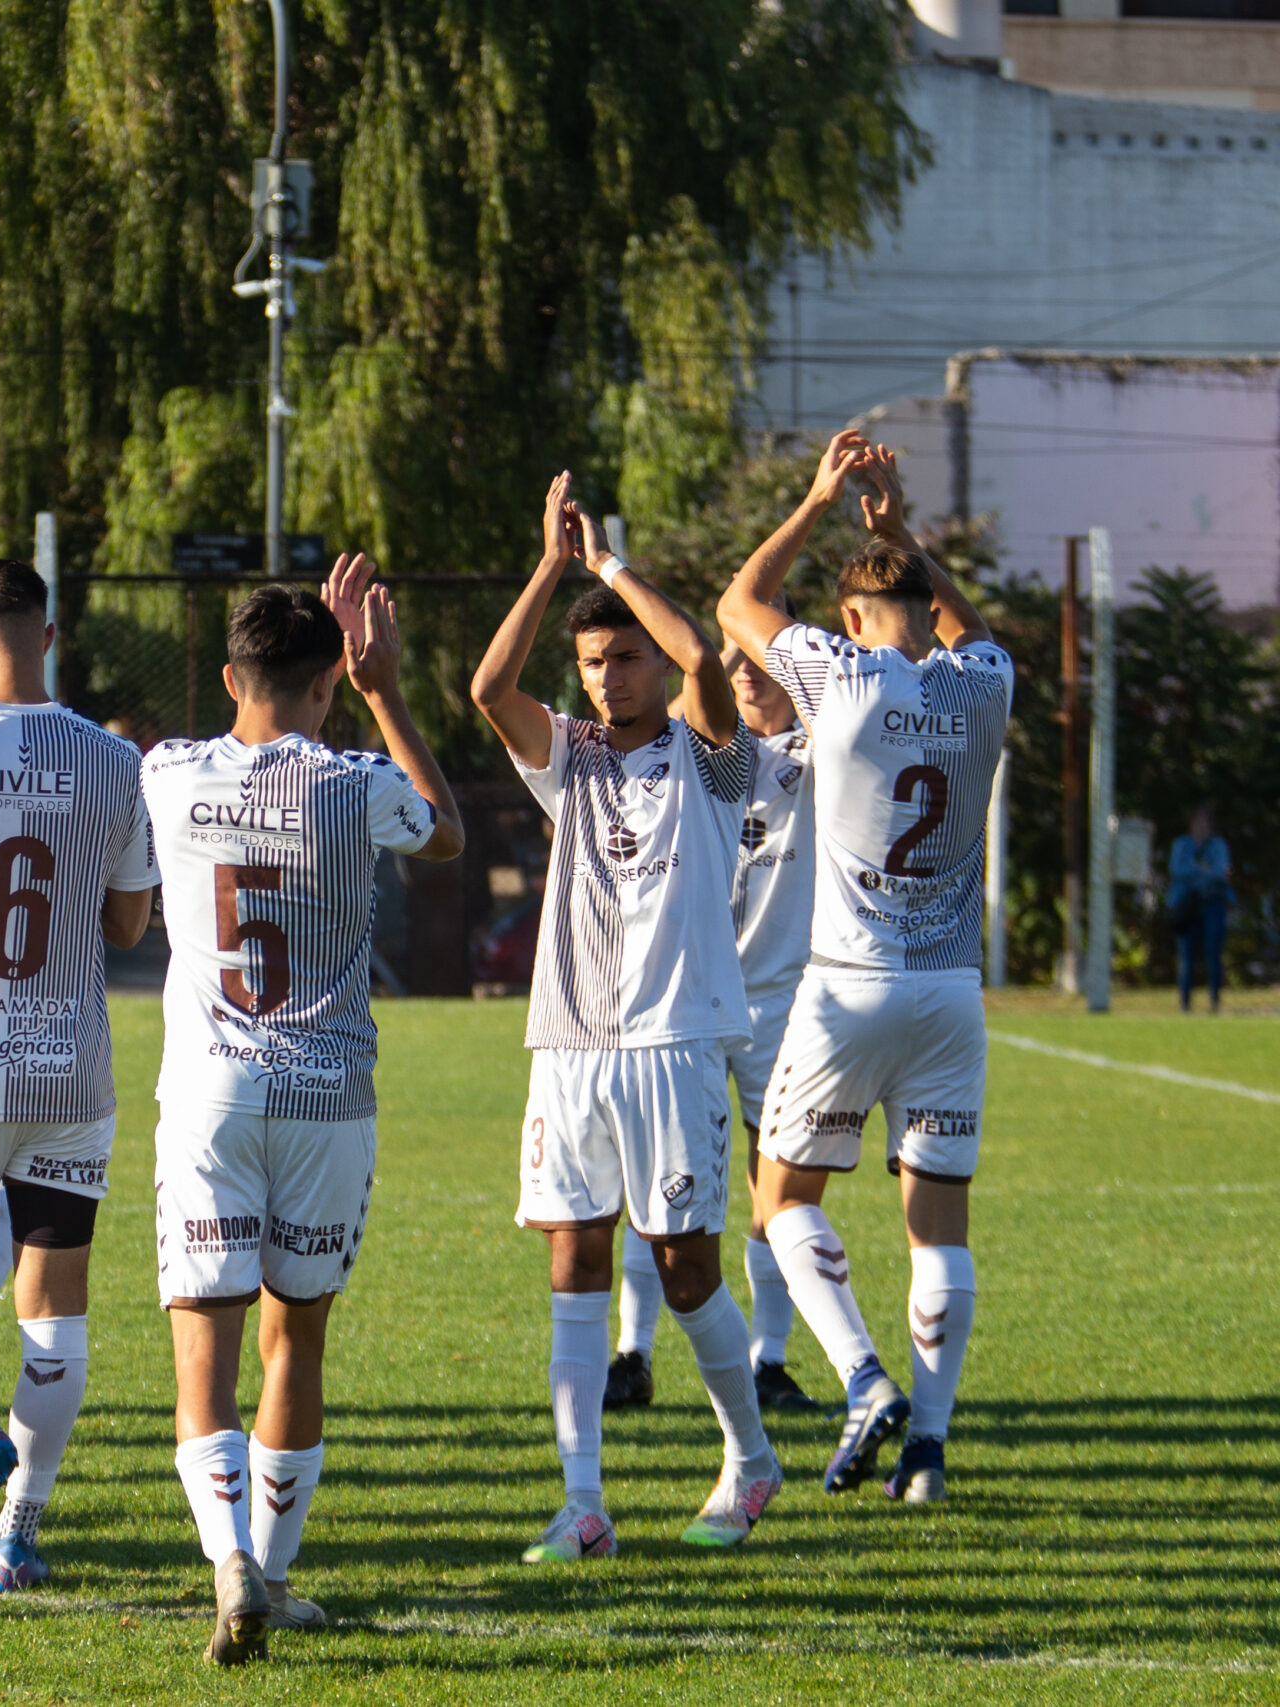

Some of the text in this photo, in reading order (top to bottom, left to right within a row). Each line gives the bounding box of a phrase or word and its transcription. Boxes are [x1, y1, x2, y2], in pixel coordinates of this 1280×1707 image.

[884, 709, 966, 735] CIVILE
[879, 734, 967, 750] PROPIEDADES
[307, 760, 363, 787] PESGRAFICA
[645, 765, 665, 790] CAP
[189, 802, 301, 833] CIVILE
[883, 764, 949, 878] 2
[190, 831, 302, 850] PROPIEDADES
[885, 875, 962, 897] RAMADA
[214, 863, 290, 1017] 5
[28, 1059, 73, 1074] Salud
[208, 1041, 343, 1070] emergencias
[293, 1072, 342, 1091] Salud
[907, 1108, 978, 1121] MATERIALES
[907, 1118, 977, 1138] MELIAN
[531, 1117, 545, 1169] 3
[32, 1155, 107, 1170] MATERIALES
[666, 1178, 688, 1200] CAP
[184, 1216, 261, 1243] SUNDOWN
[271, 1215, 346, 1239] MATERIALES
[268, 1227, 345, 1257] MELIAN
